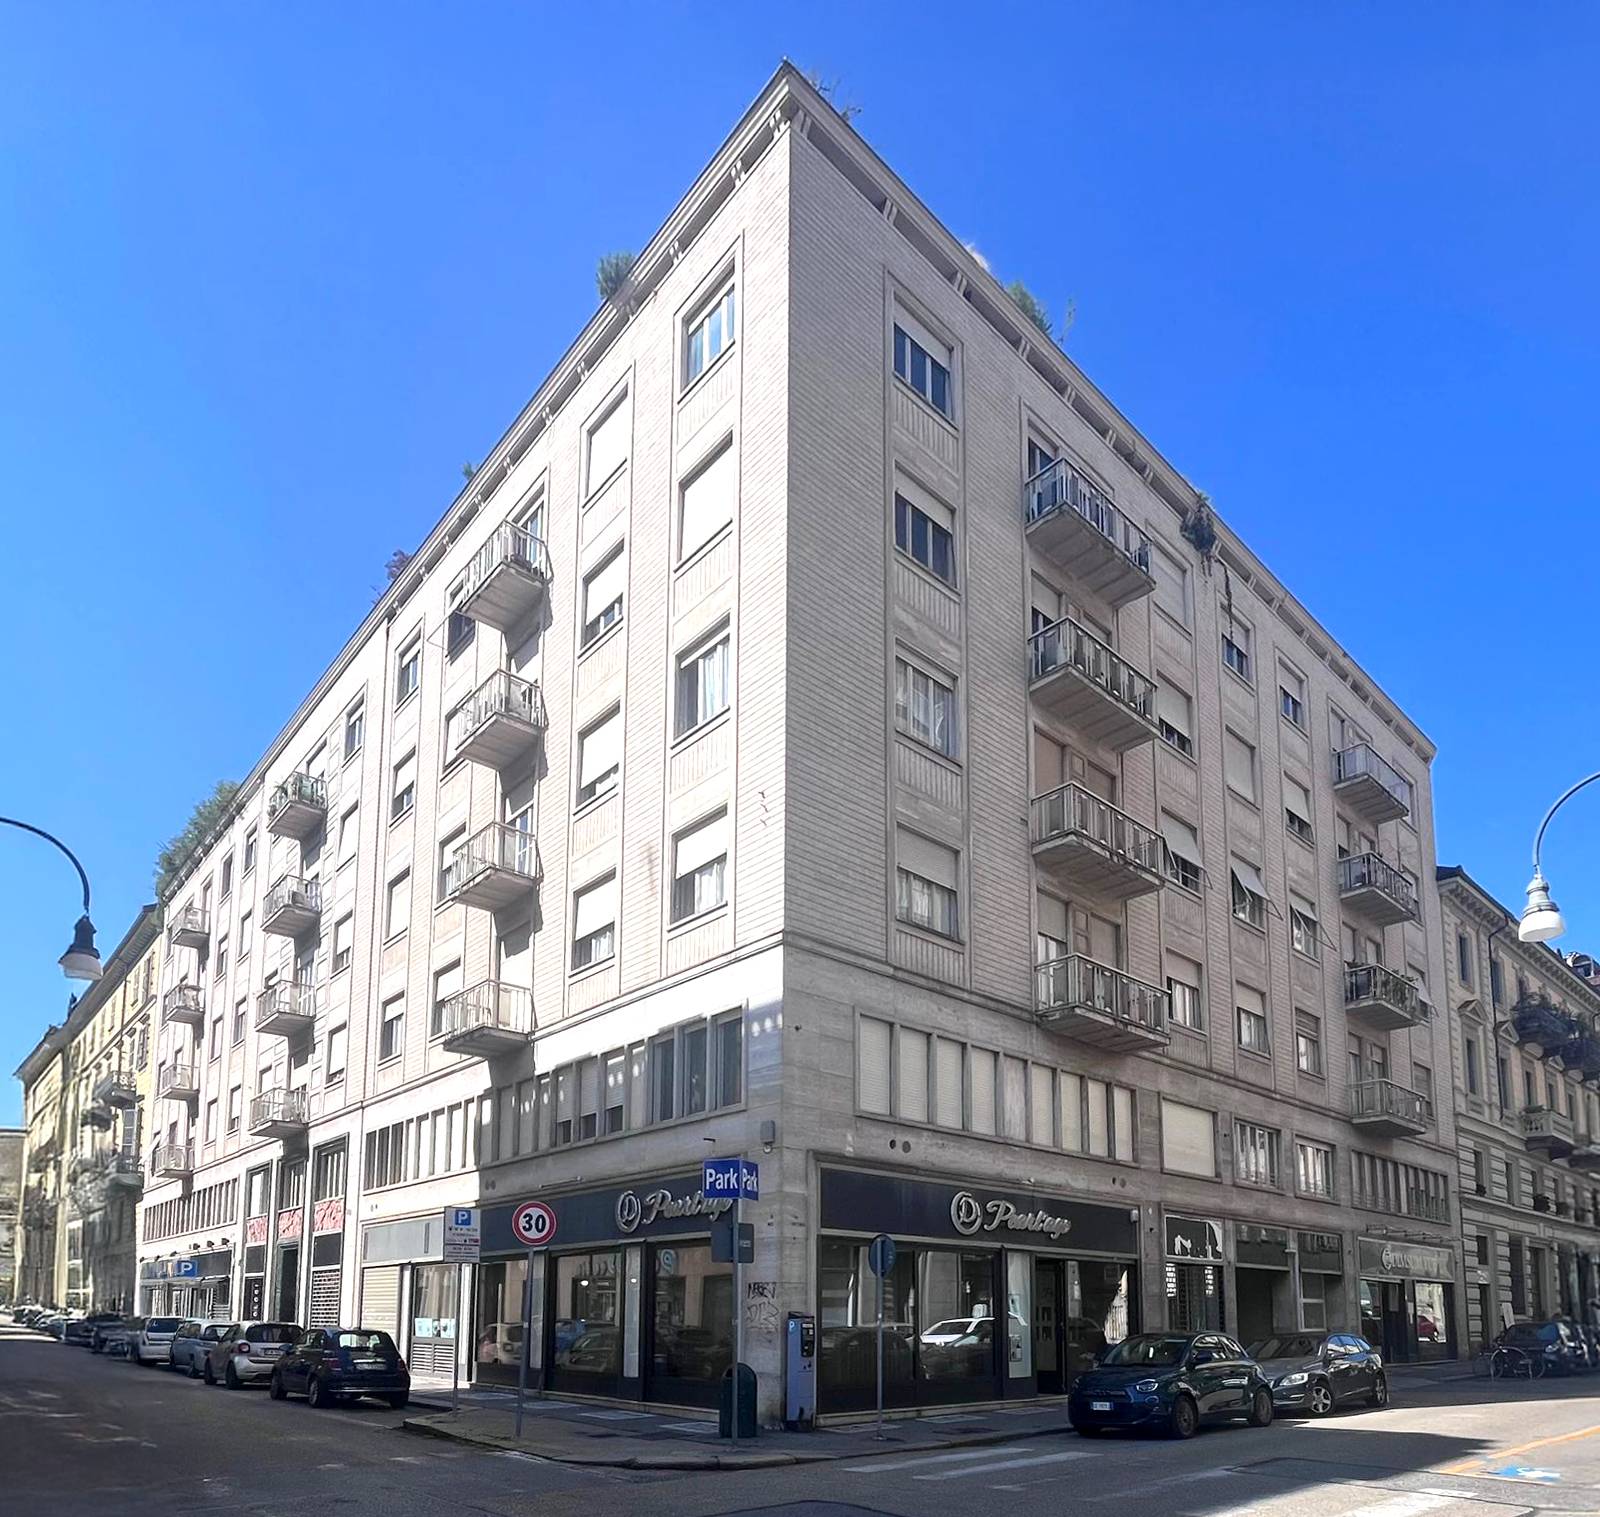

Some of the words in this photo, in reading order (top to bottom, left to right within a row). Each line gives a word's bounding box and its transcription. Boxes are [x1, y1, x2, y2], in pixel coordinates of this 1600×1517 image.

[705, 1168, 738, 1190] Park
[742, 1167, 758, 1191] Park
[458, 1211, 468, 1224] P
[522, 1213, 547, 1233] 30
[181, 1261, 193, 1275] P
